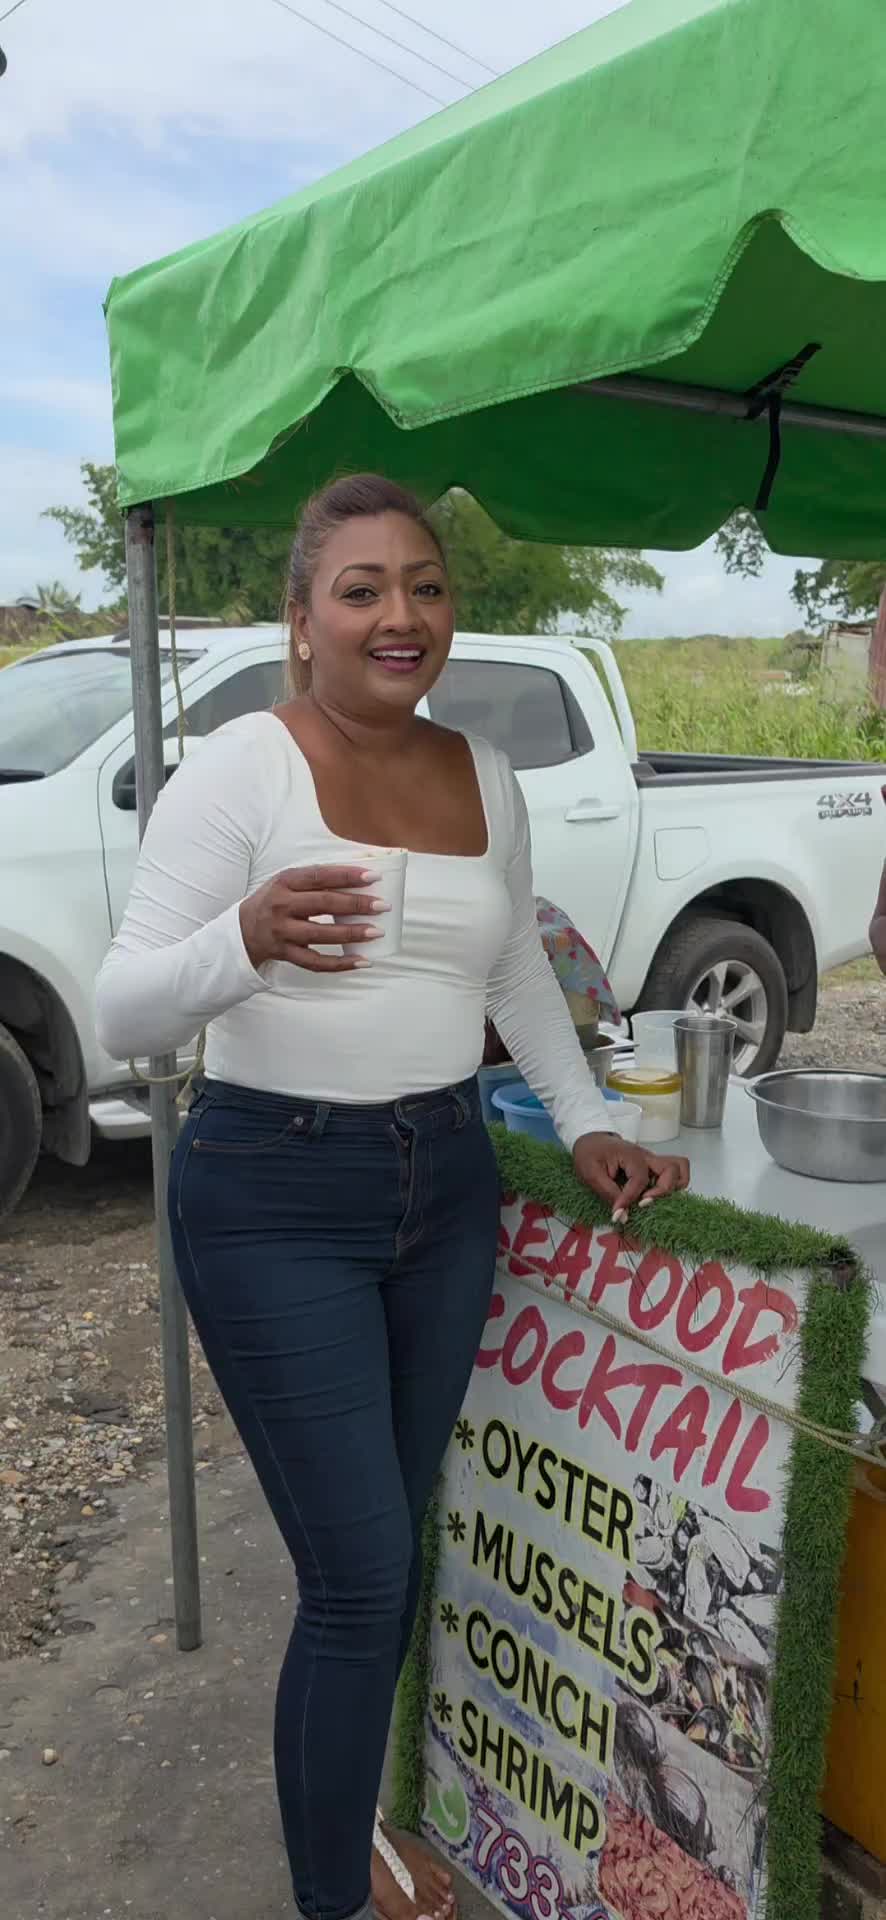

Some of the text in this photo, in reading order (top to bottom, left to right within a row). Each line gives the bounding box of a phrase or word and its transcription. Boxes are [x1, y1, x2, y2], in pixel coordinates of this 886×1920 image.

[482, 1420, 633, 1560] OYSTER
[472, 1511, 654, 1684] MUSSELS
[466, 1611, 609, 1764] CONCH
[460, 1700, 600, 1850] SHRIMP
[474, 1804, 609, 1920] 733
